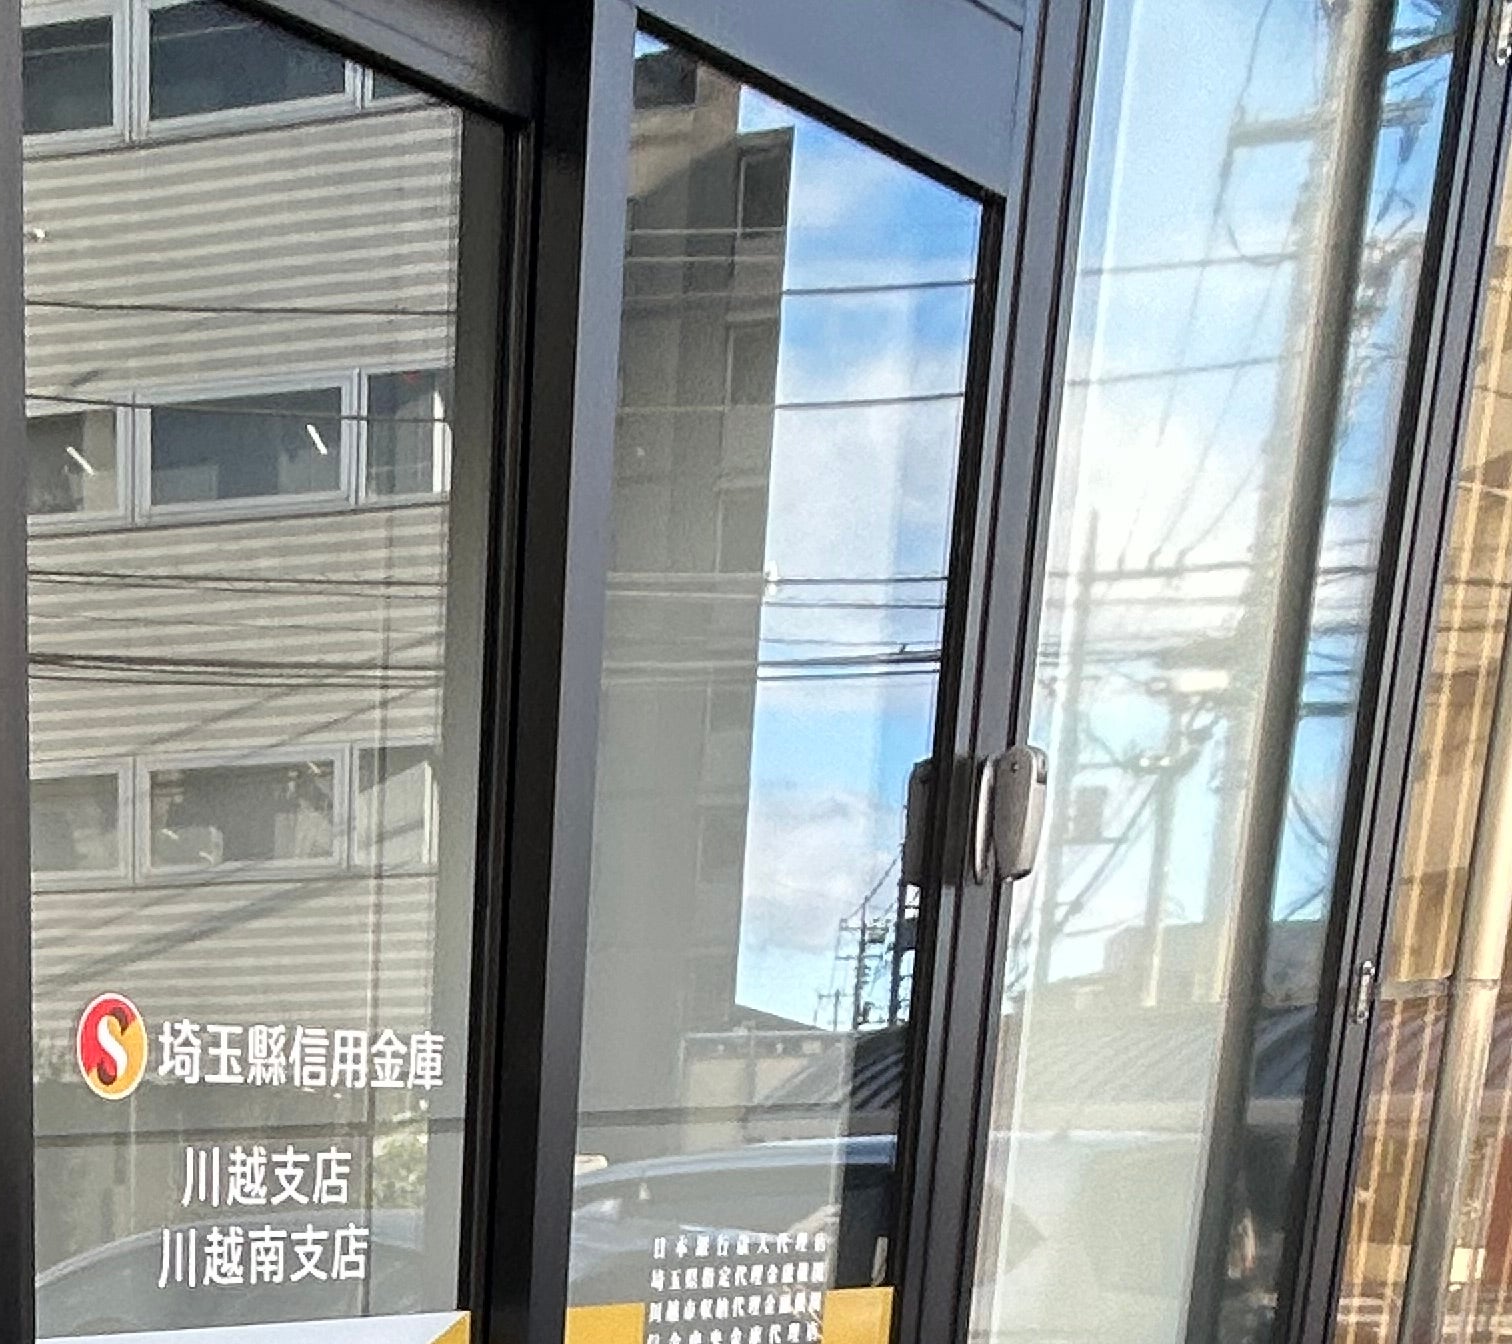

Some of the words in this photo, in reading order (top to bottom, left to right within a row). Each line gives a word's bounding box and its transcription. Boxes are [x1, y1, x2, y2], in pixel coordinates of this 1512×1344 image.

[157, 1018, 445, 1090] 埼玉縣信用金庫
[181, 1146, 352, 1208] 川越支店
[157, 1223, 370, 1289] 川越南支店
